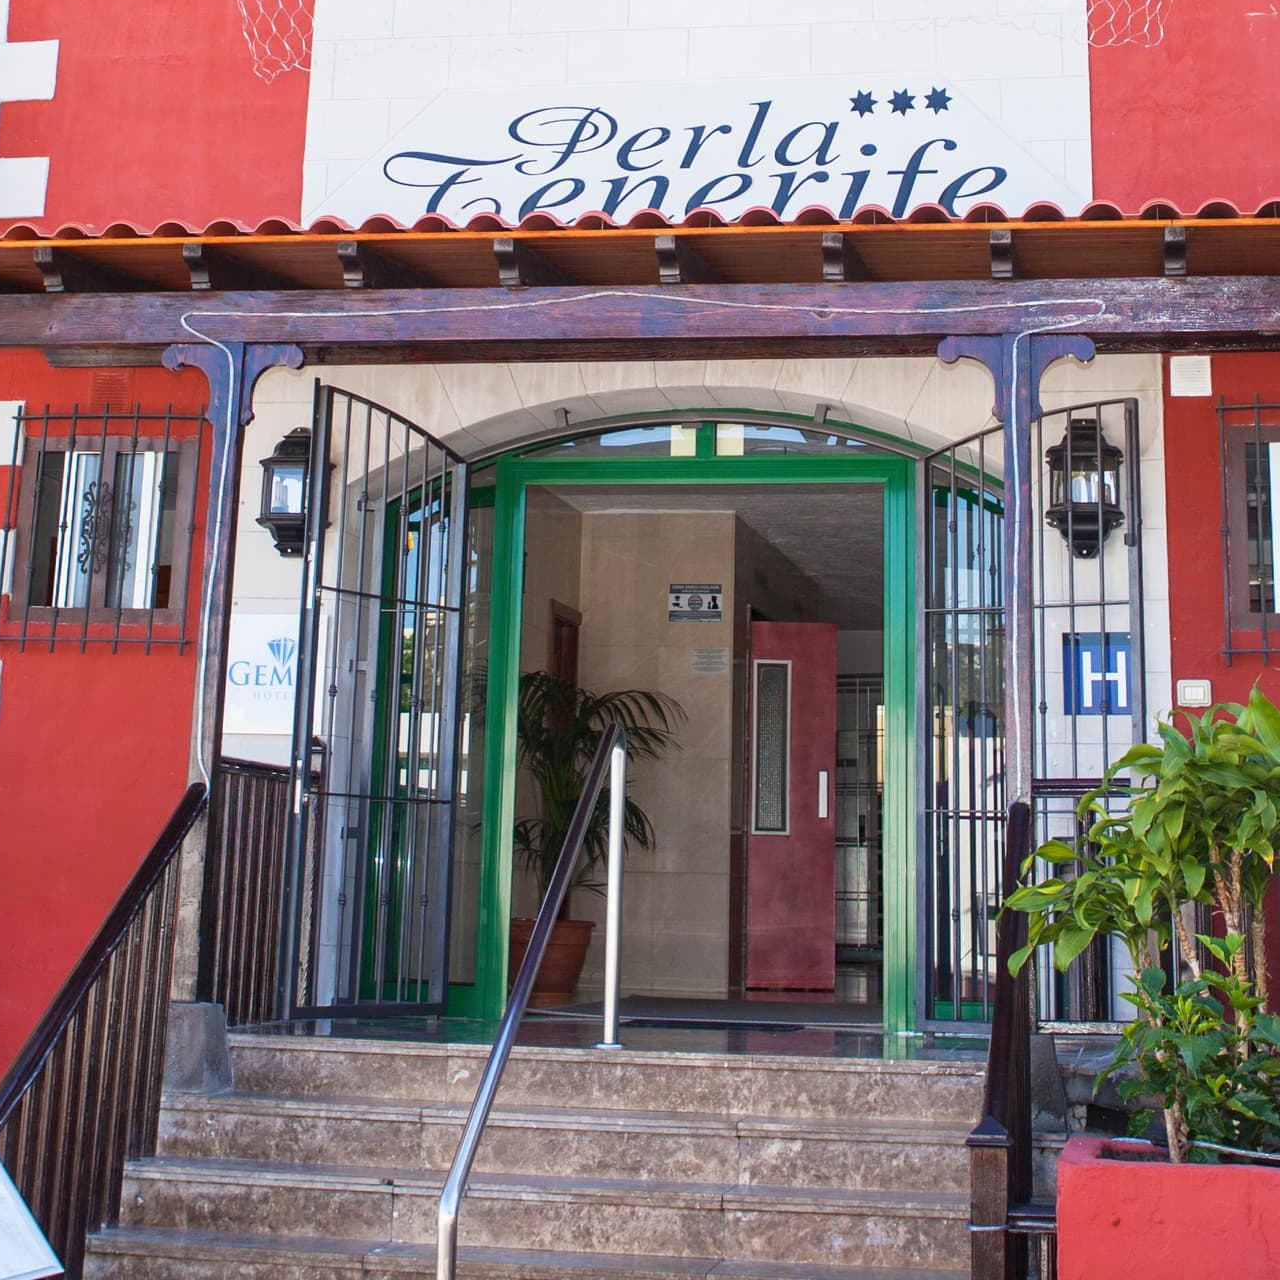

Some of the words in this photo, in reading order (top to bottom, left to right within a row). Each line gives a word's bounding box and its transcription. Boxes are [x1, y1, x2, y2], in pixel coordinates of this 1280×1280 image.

[508, 100, 840, 175] Perla
[384, 138, 1008, 222] Tenerife
[1082, 651, 1127, 707] H
